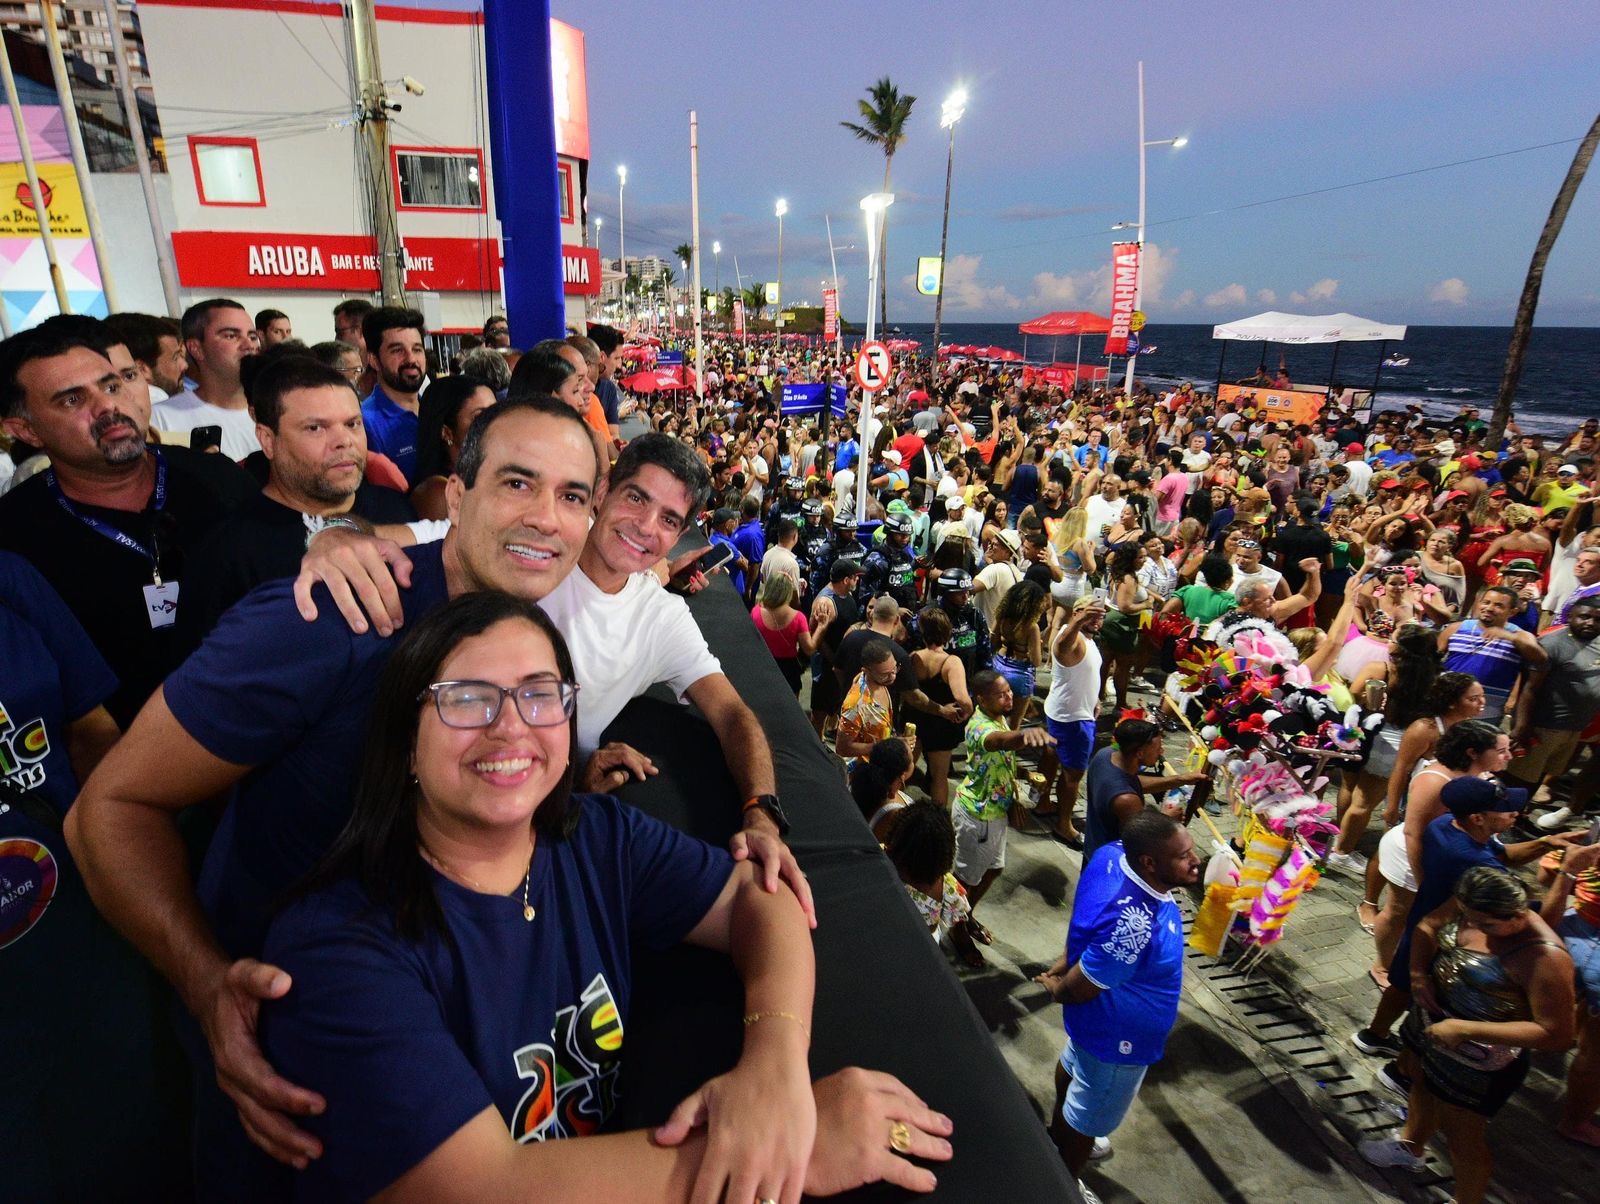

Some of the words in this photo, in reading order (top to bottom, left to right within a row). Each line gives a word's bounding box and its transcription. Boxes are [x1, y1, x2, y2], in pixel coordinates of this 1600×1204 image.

[13, 209, 66, 223] Bouhe
[248, 245, 325, 276] ARUBA
[331, 254, 353, 270] BAR
[354, 255, 361, 269] E
[362, 255, 434, 271] RESANTE
[1110, 253, 1137, 338] BRAHMA
